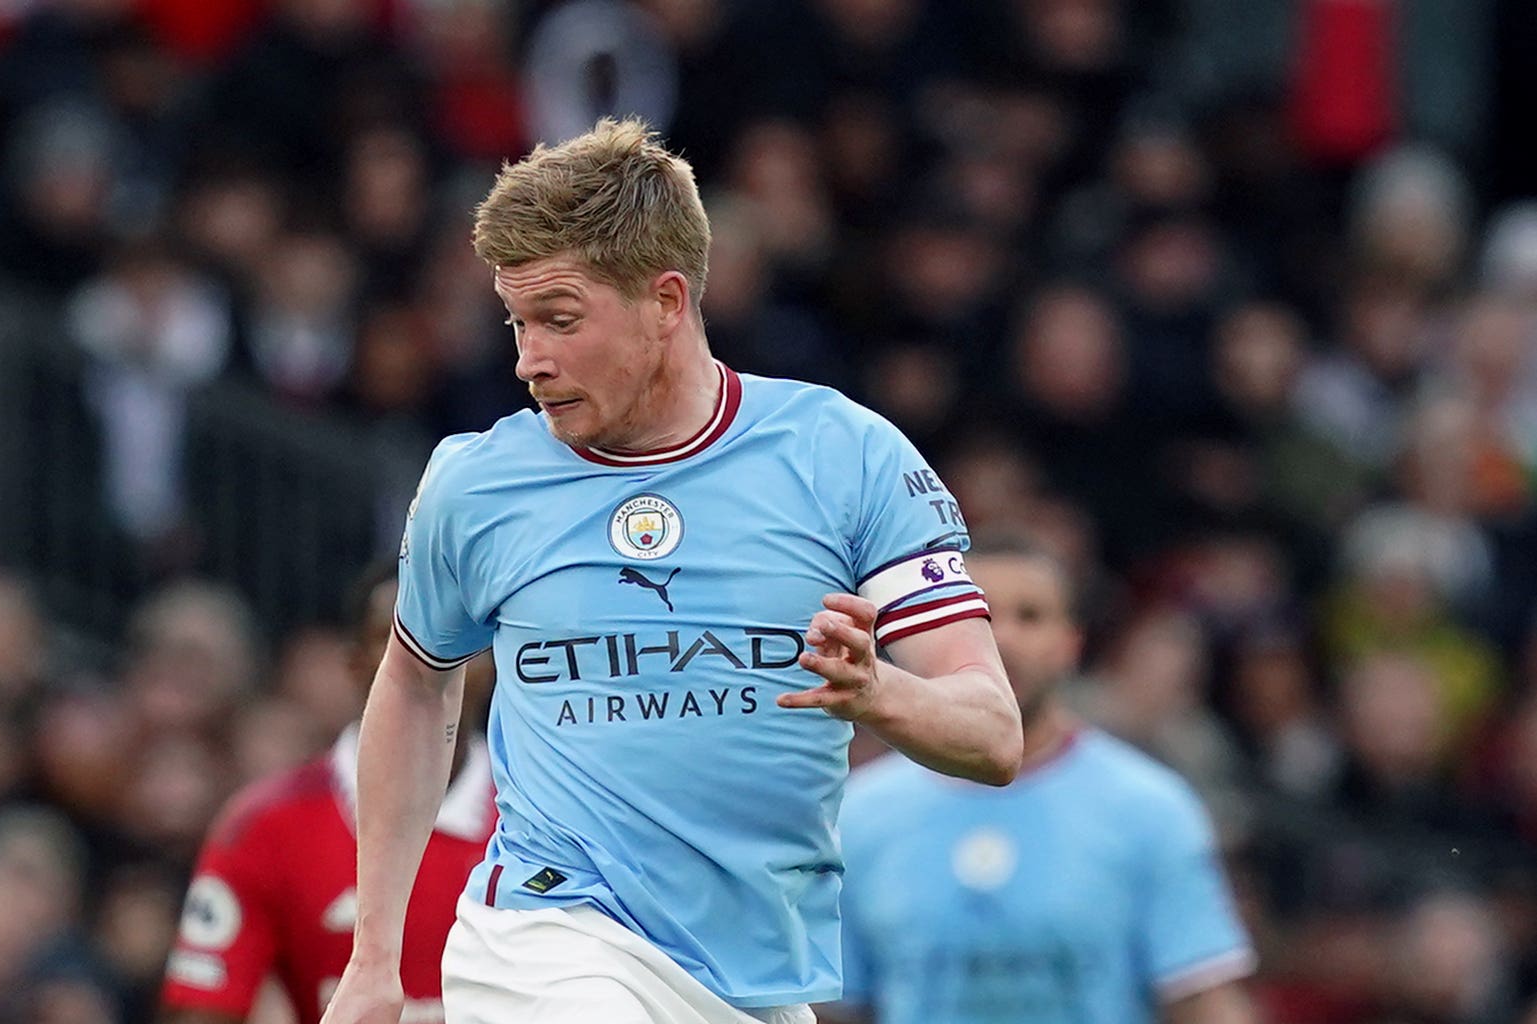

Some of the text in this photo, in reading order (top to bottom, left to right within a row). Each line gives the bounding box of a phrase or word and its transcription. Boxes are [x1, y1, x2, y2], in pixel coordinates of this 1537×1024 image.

[902, 468, 943, 497] NE
[616, 499, 675, 523] MANCHESTER
[516, 628, 805, 684] ETIHAD
[556, 686, 759, 727] AIRWAYS
